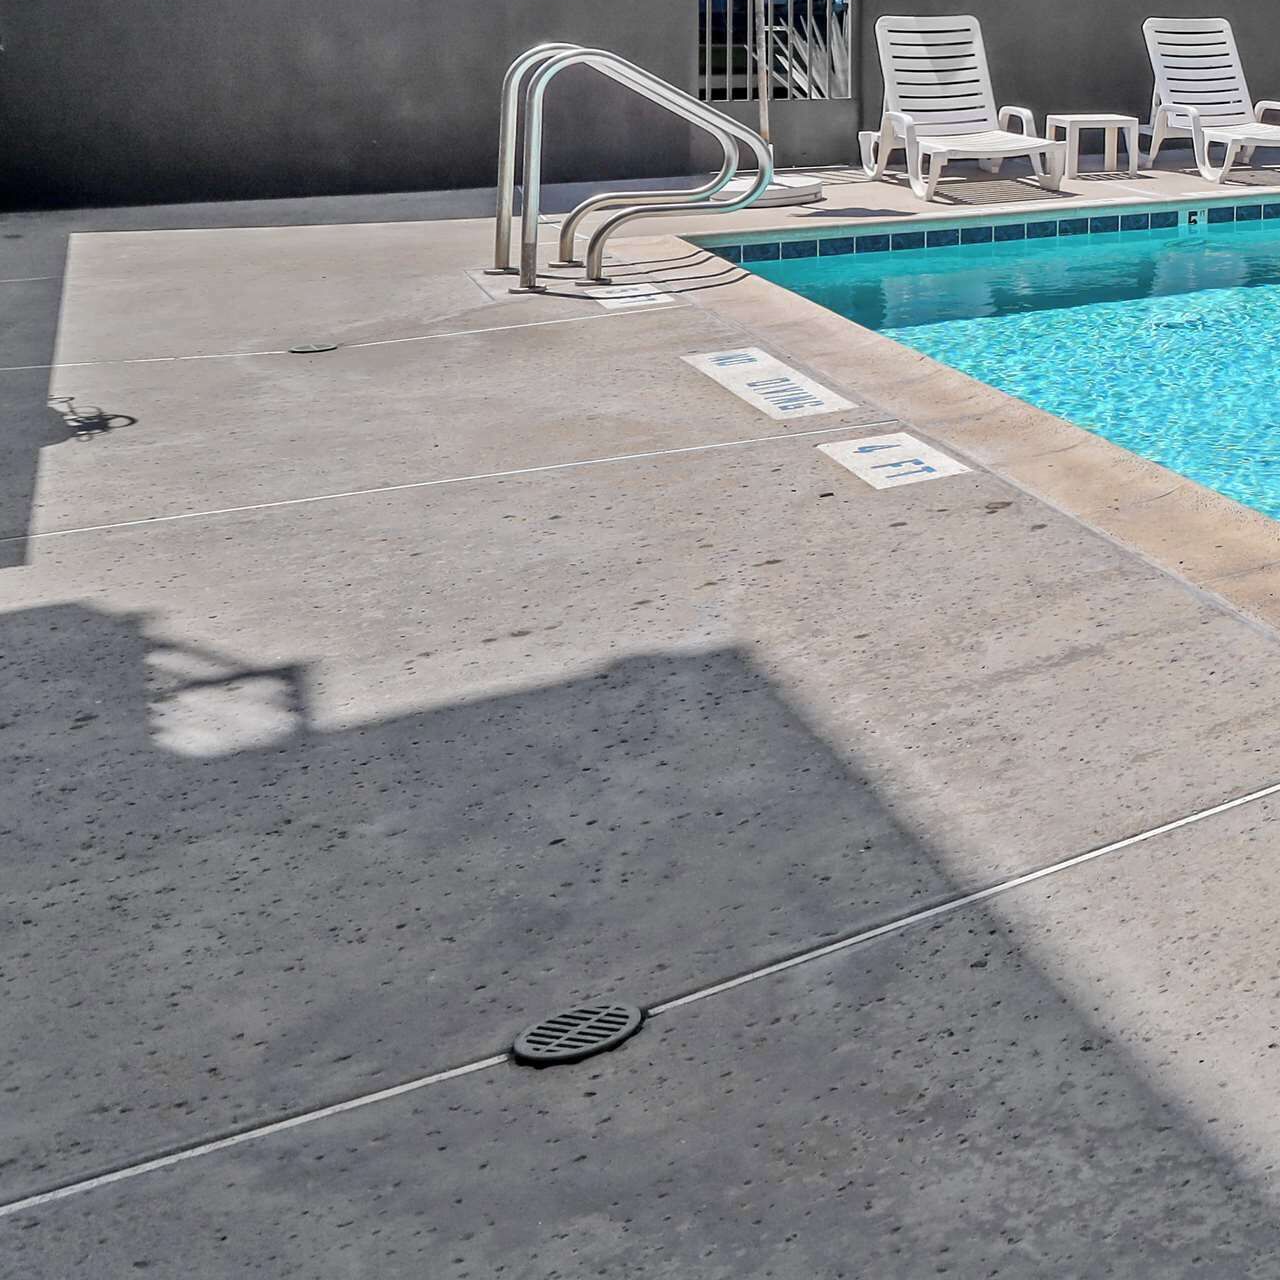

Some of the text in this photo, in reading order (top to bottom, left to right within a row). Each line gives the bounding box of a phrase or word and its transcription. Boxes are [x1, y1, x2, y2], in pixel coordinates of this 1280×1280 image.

[1188, 210, 1198, 225] 5
[708, 353, 825, 411] NO DIVING
[853, 444, 938, 479] 4 FT
